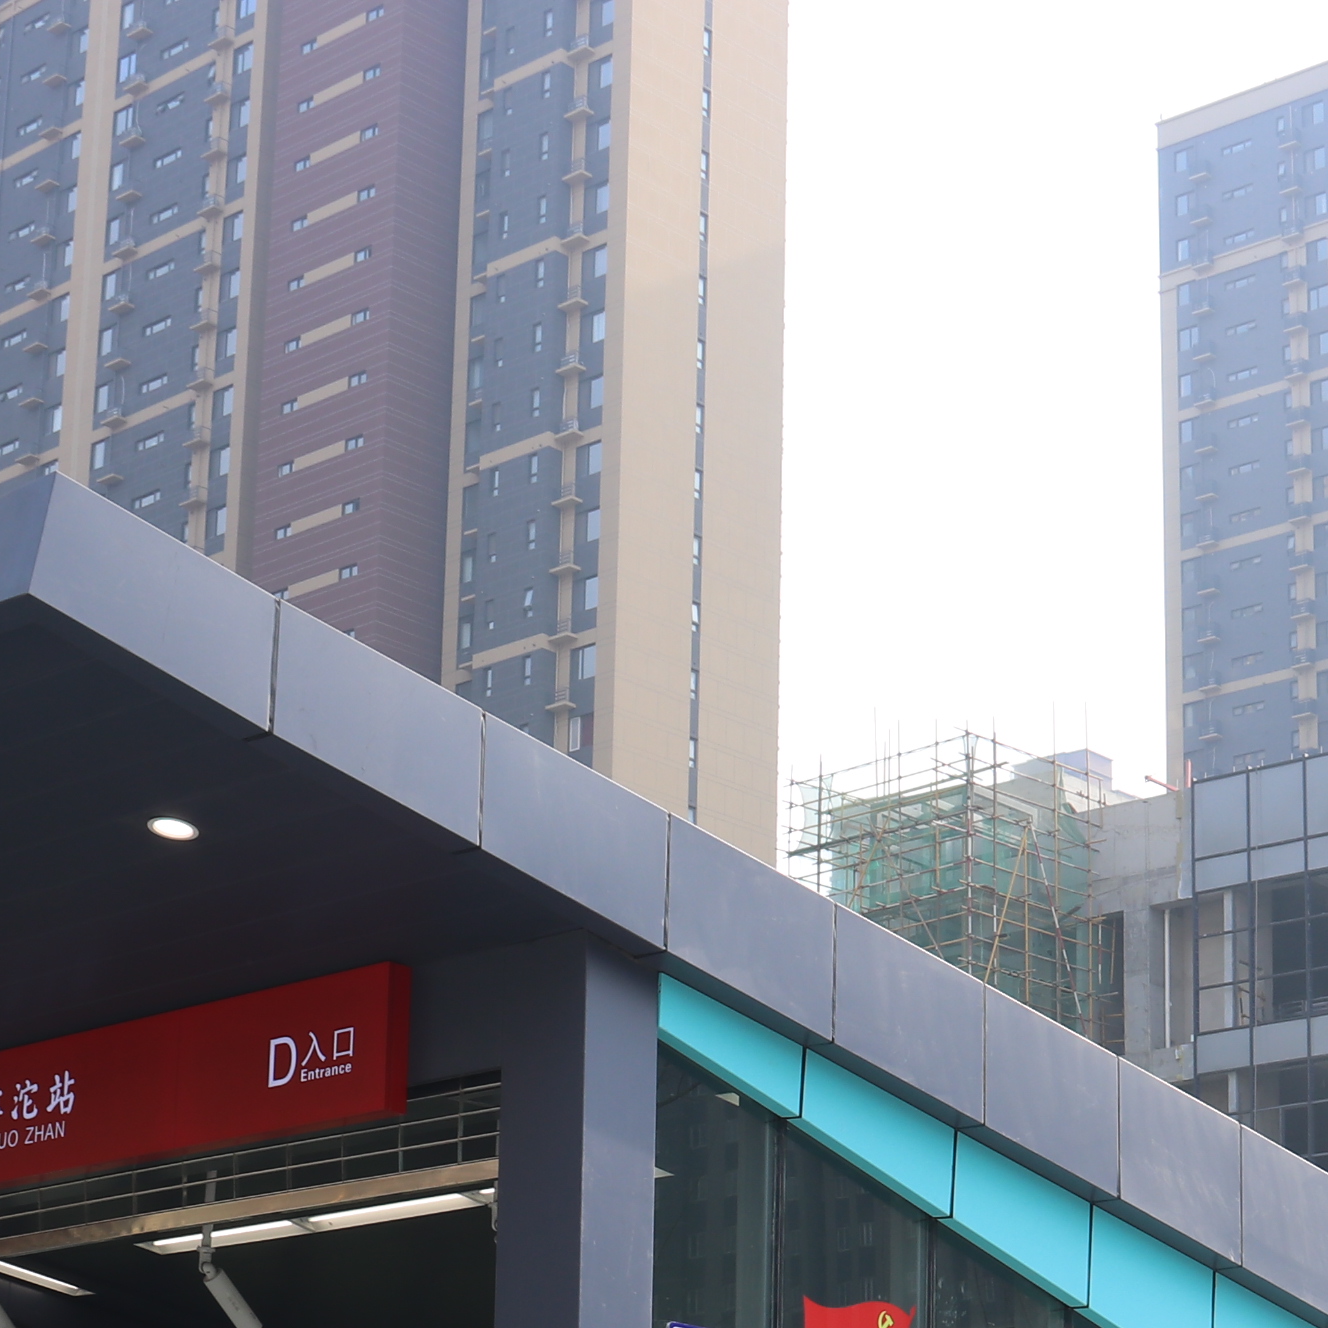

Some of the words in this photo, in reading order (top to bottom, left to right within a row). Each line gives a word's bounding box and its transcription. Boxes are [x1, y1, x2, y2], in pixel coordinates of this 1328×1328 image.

[268, 1036, 297, 1088] D
[301, 1026, 355, 1067] 入口
[300, 1063, 352, 1082] Entrance
[24, 1121, 65, 1145] ZHAN
